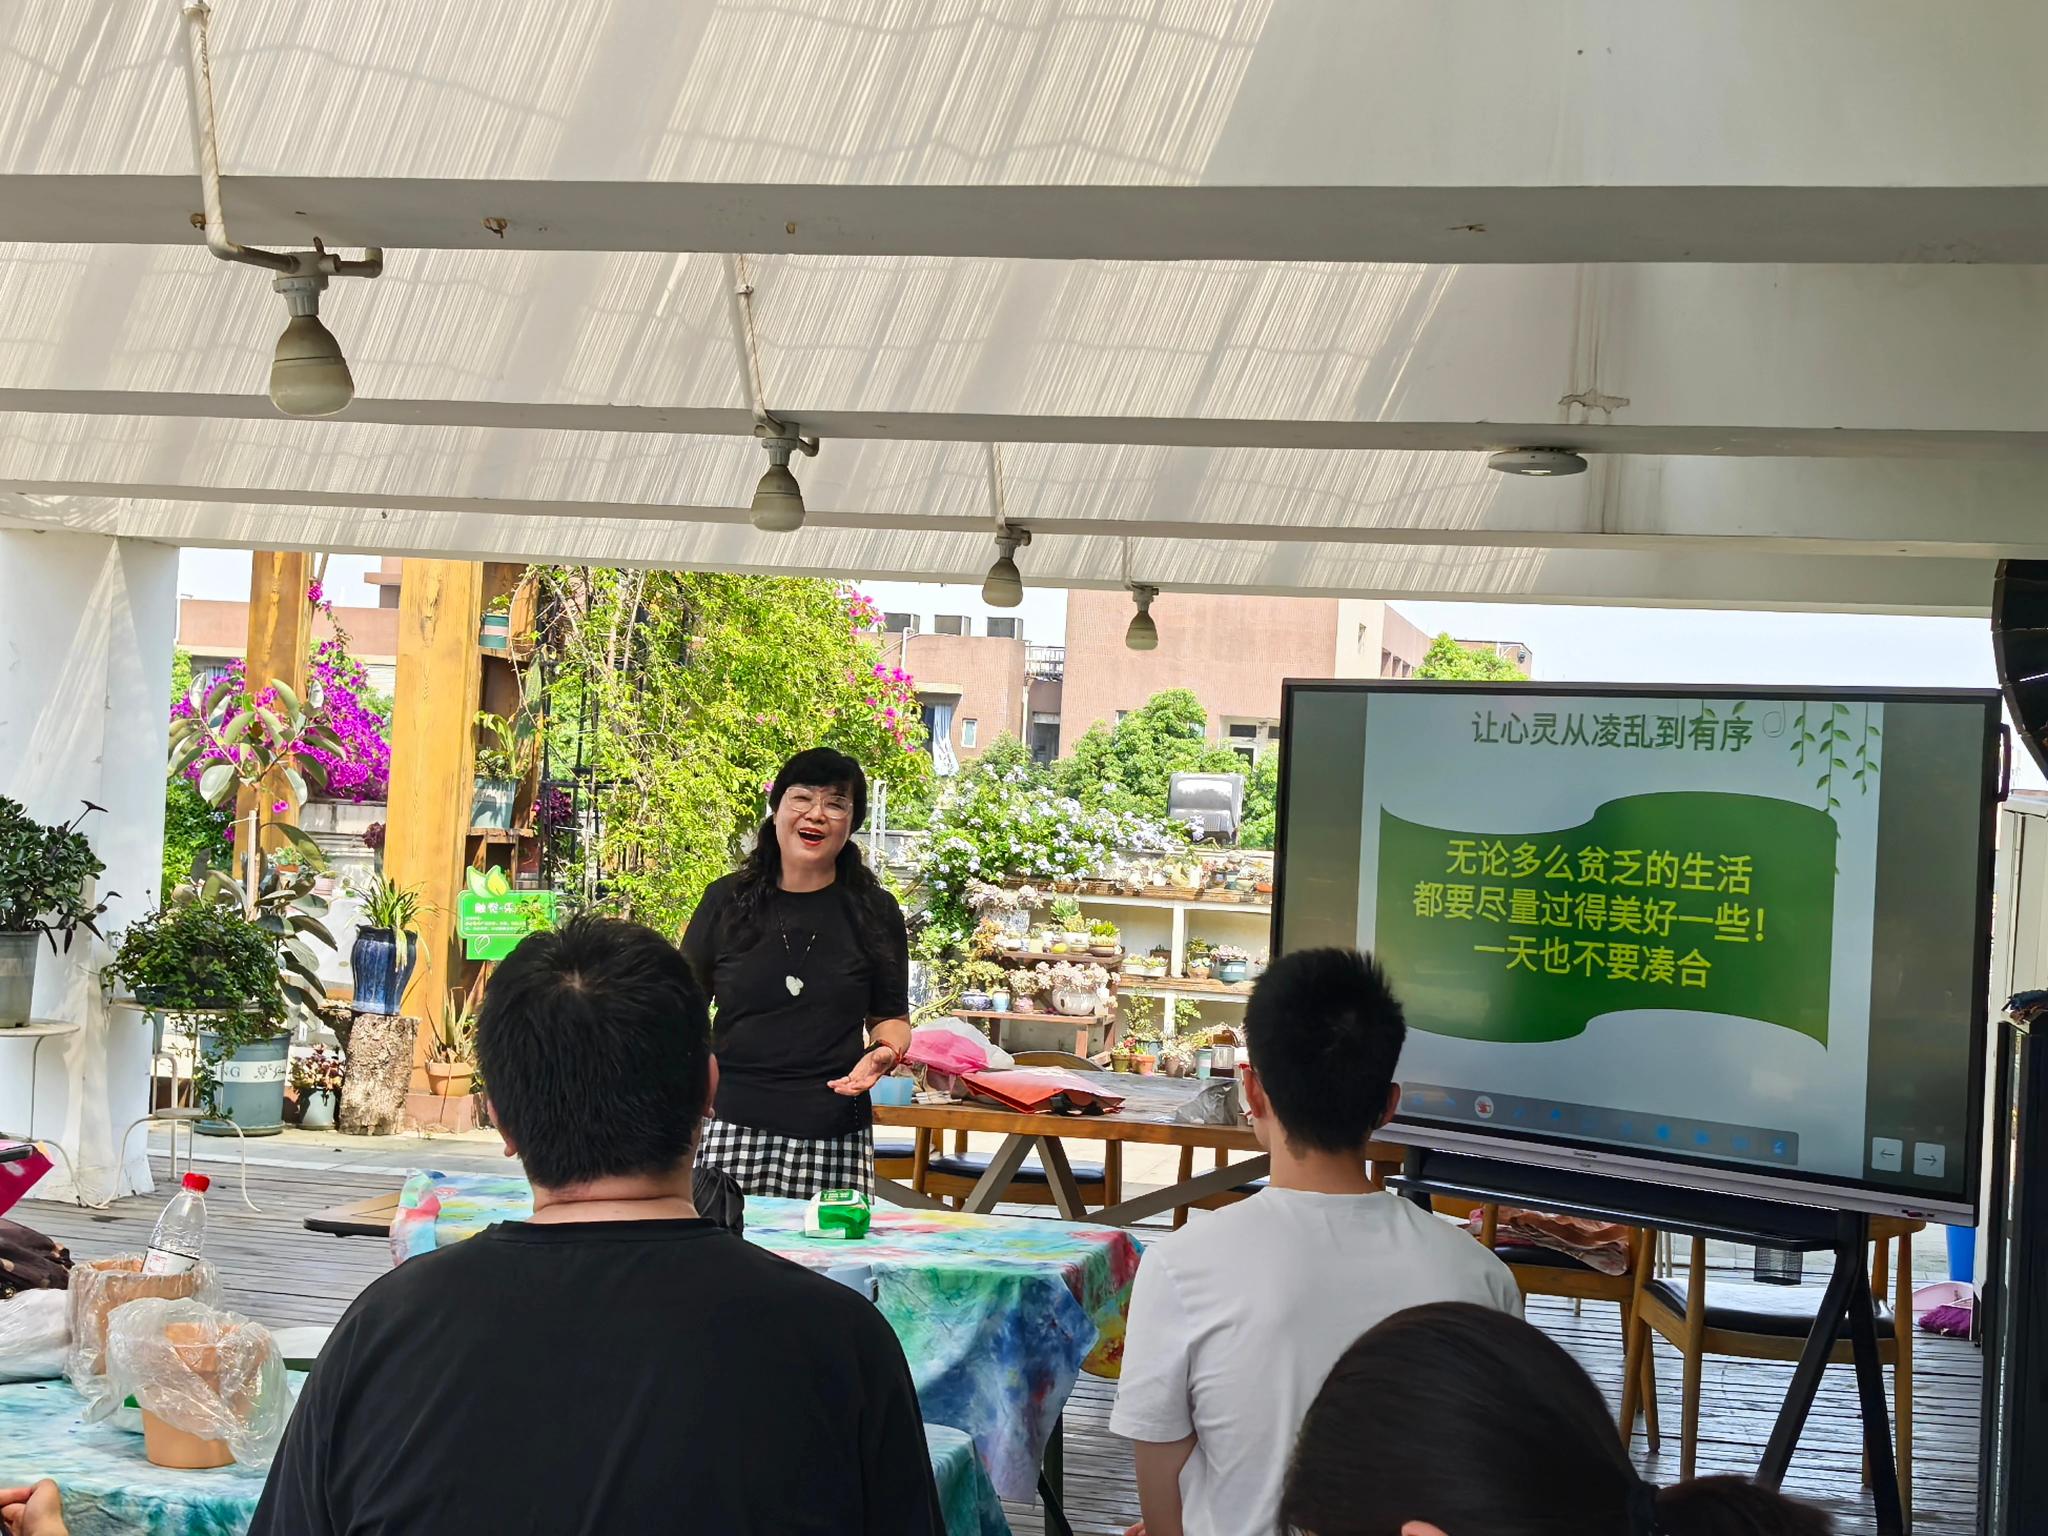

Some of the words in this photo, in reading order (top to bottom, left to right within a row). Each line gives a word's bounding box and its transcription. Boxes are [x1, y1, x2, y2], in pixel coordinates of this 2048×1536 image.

[1472, 710, 1753, 751] 让心灵从凌乱到有序
[1446, 839, 1753, 895] 无论多么贫乏的生活
[1474, 935, 1712, 988] 一天也不要凑合
